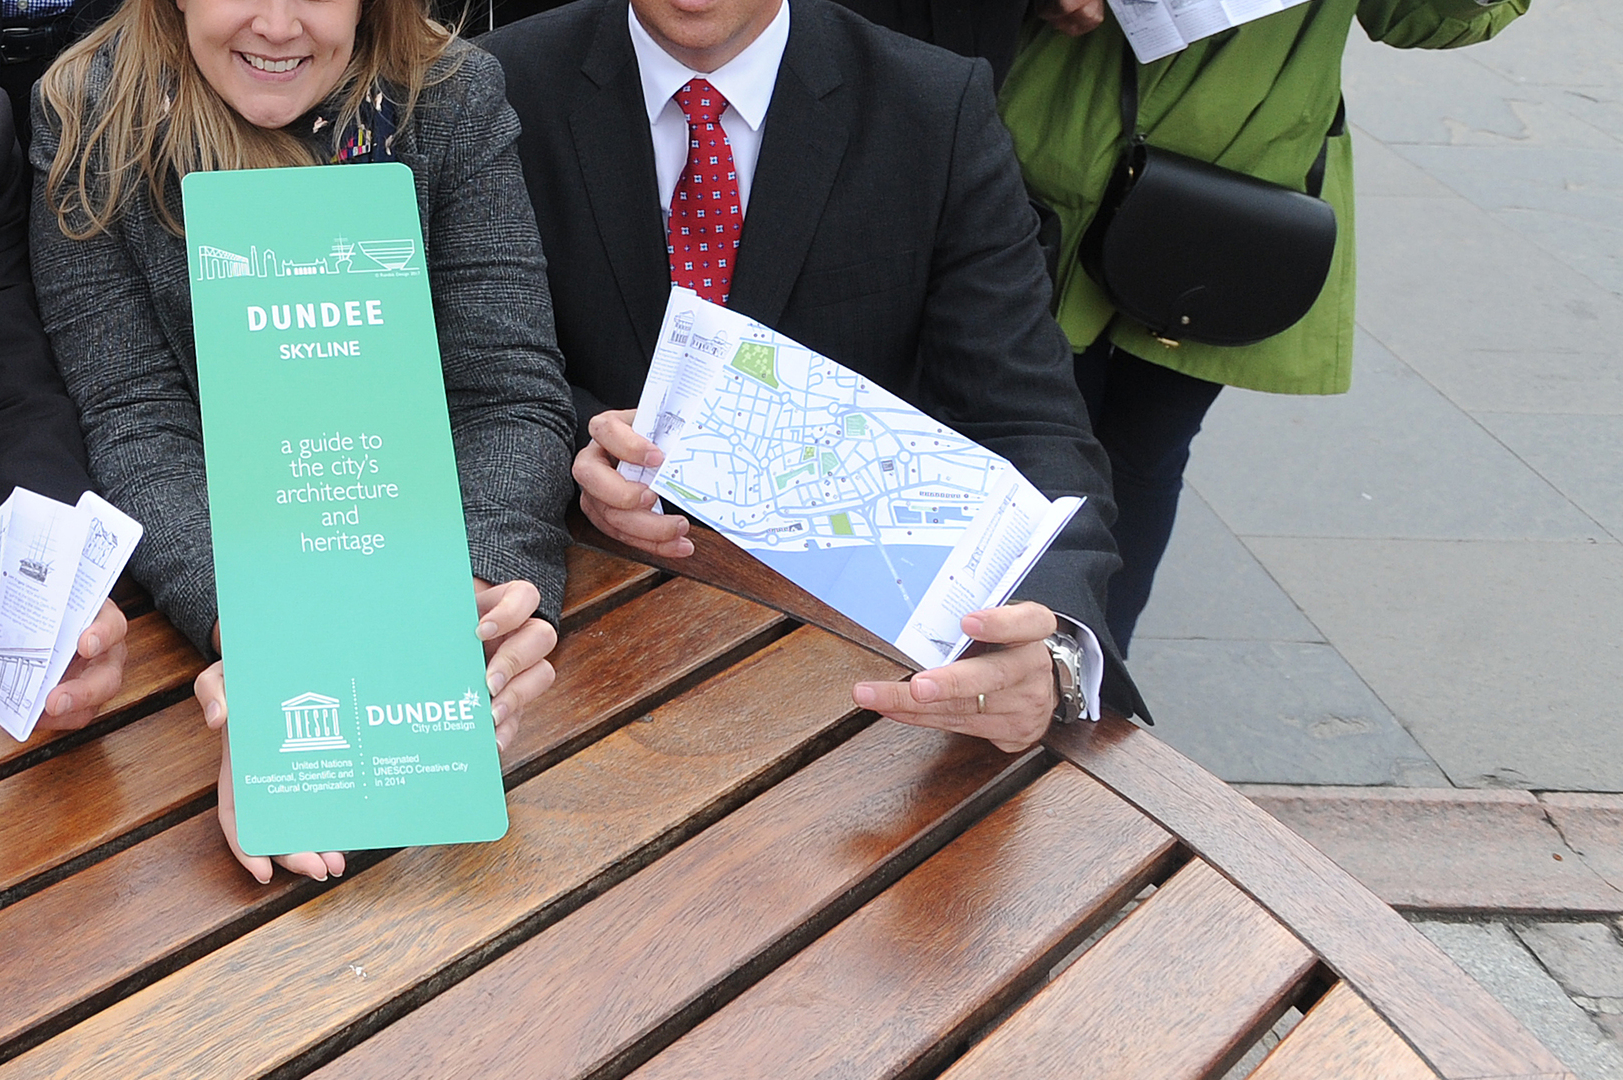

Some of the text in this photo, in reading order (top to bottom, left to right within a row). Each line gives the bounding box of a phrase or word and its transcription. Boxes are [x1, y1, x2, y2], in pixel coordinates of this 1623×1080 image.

[247, 299, 385, 332] DUNDEE
[279, 340, 361, 360] SKYLINE
[280, 431, 383, 458] a guide to
[289, 454, 379, 480] the city's
[276, 480, 399, 505] architecture
[321, 505, 360, 526] and
[300, 530, 386, 555] heritage
[365, 700, 474, 726] DUNDEE
[285, 708, 341, 739] UNESCO
[411, 720, 476, 734] City of Design
[291, 758, 353, 771] United Nations
[372, 753, 420, 766] Designated
[373, 761, 469, 777] UNESCO Creative City
[244, 768, 354, 785] Educational, Scientific and
[384, 776, 406, 787] 2014
[267, 780, 355, 794] Cultural Organization
